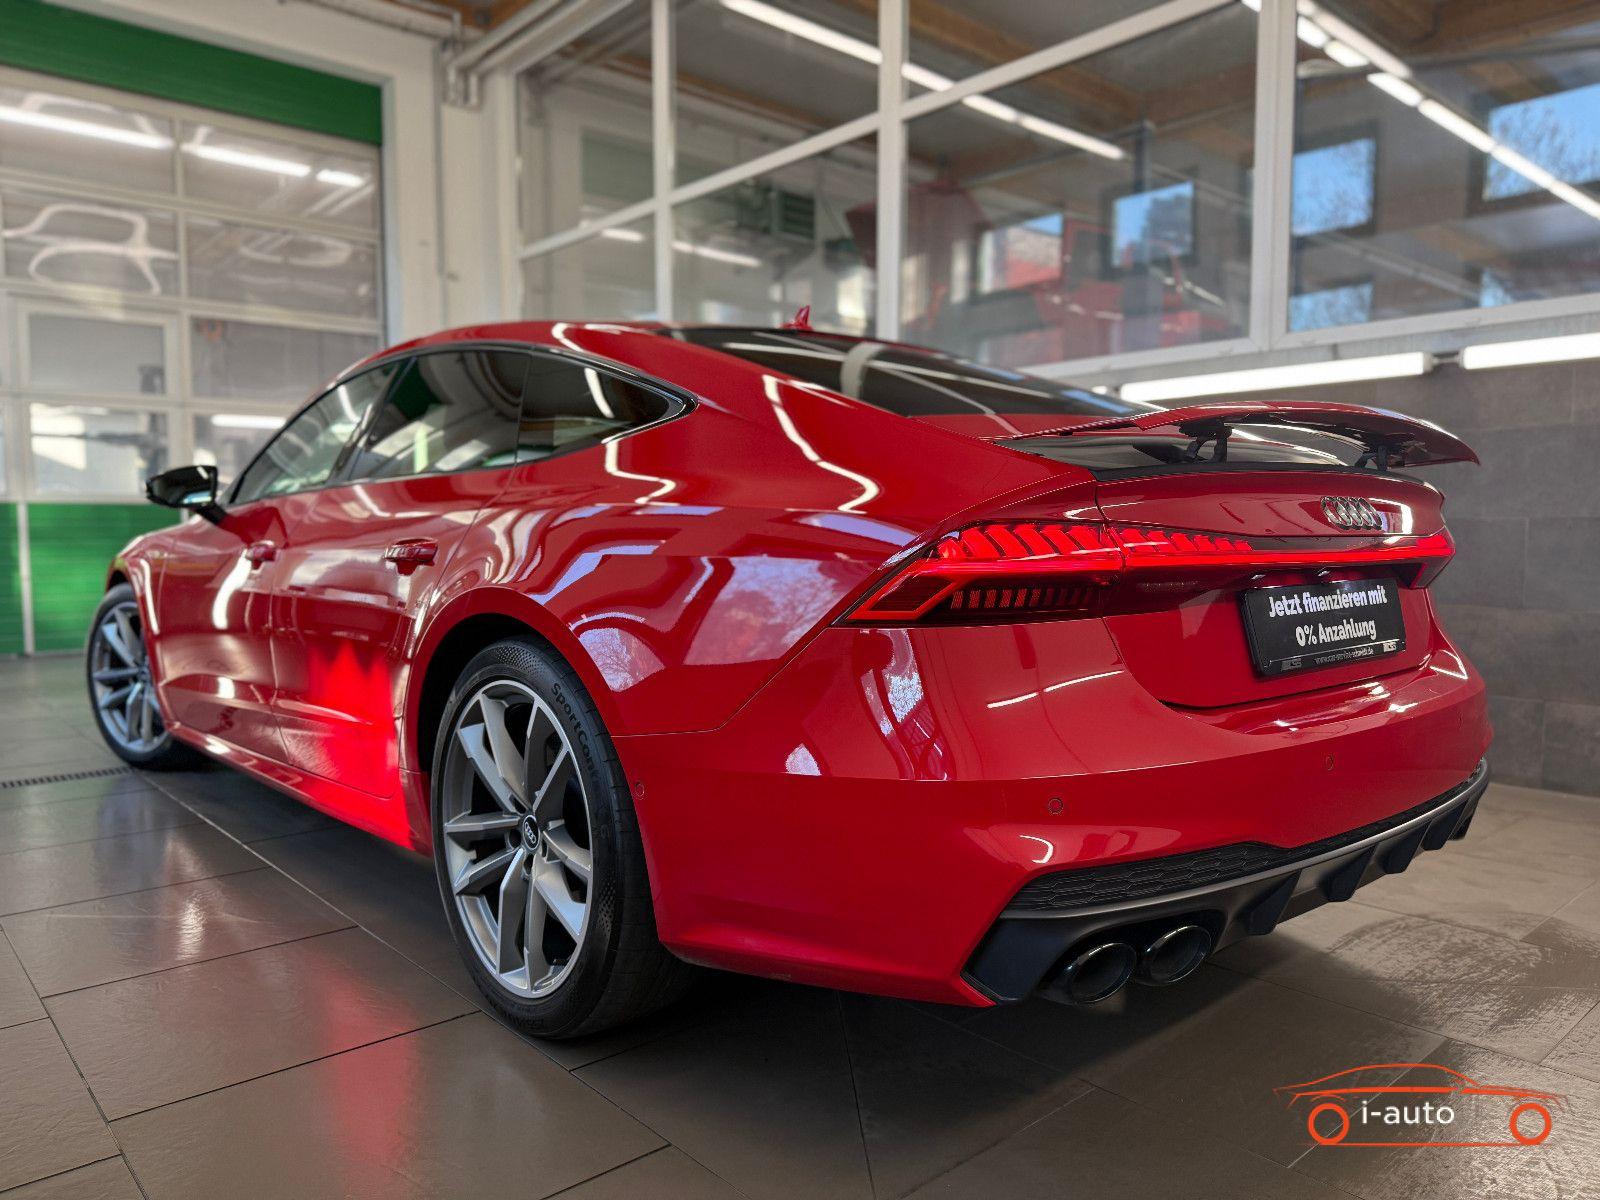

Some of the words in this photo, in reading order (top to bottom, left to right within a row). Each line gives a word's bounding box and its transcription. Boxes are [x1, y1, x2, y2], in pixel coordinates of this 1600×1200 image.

[1268, 594, 1303, 618] Jetzt
[1303, 589, 1367, 613] finanzieren
[1367, 584, 1388, 605] mit
[1295, 624, 1318, 647] 0%
[1318, 618, 1377, 641] Anzahlung
